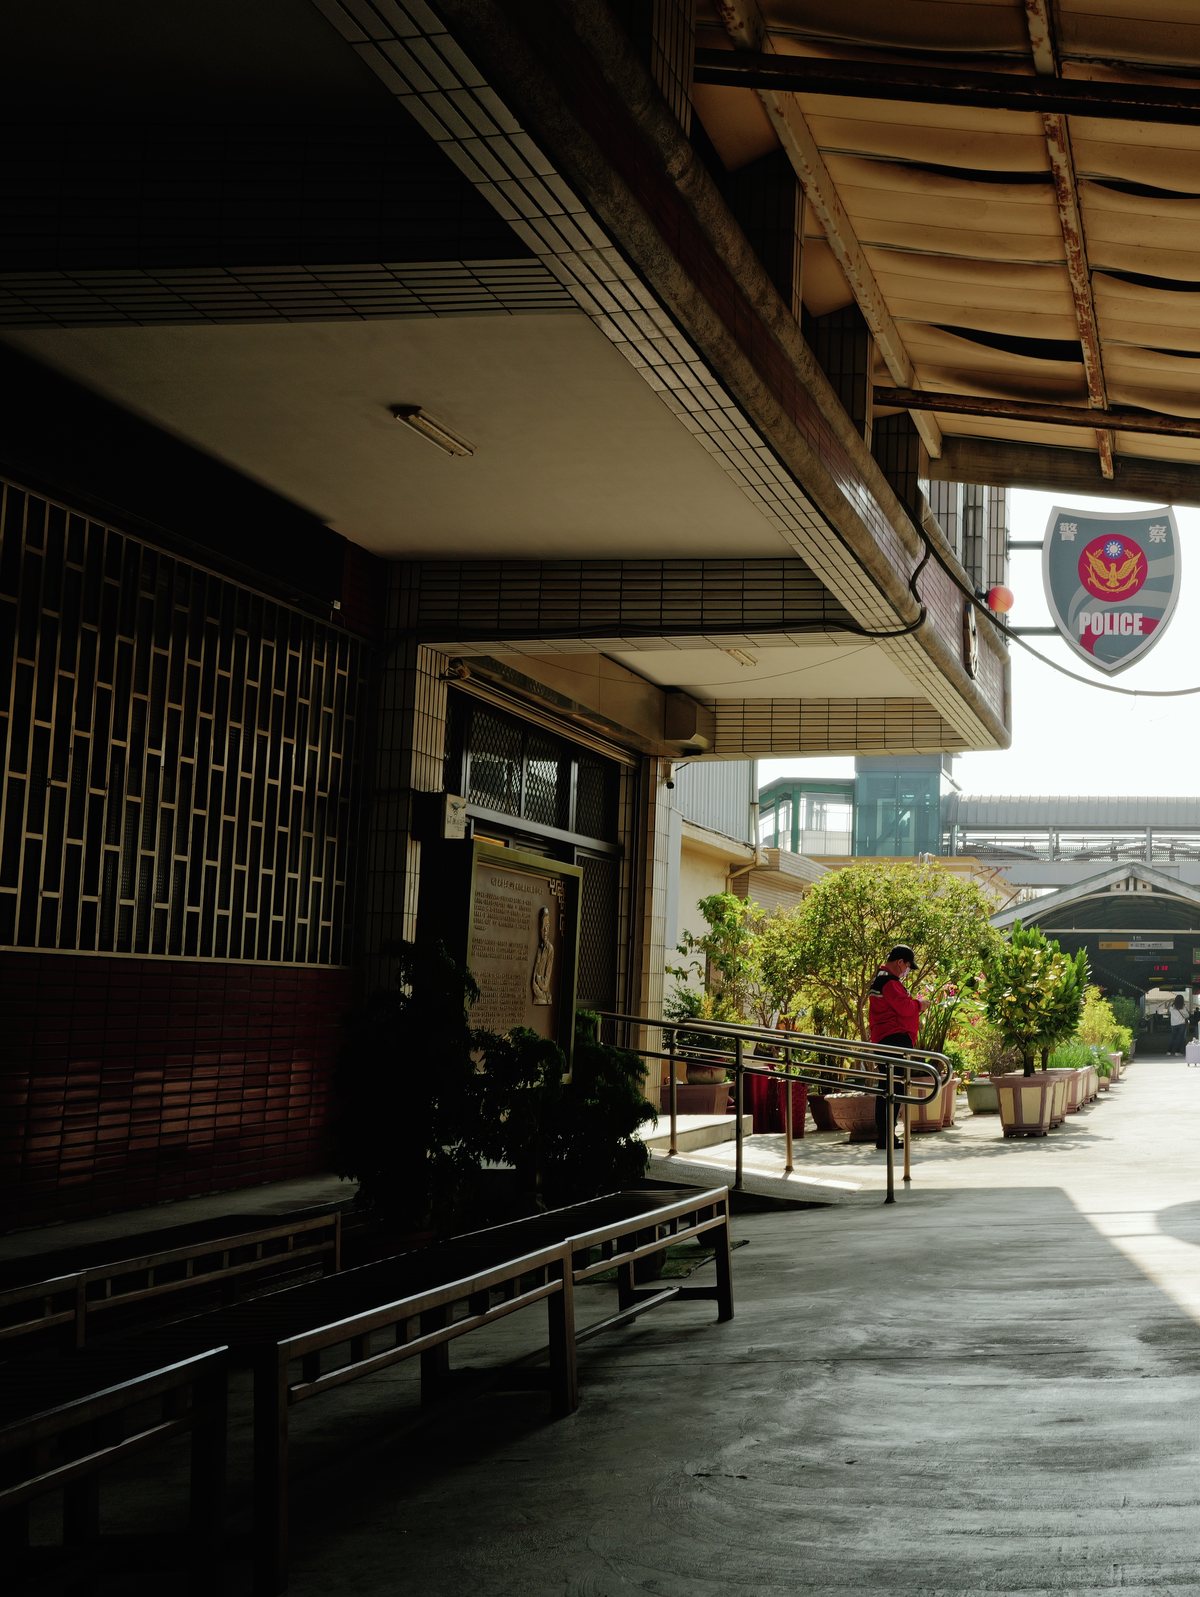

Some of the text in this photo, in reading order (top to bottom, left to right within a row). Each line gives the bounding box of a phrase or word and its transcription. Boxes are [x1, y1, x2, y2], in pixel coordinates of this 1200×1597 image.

[1059, 522, 1167, 543] 警 察
[1078, 612, 1144, 636] POLICE
